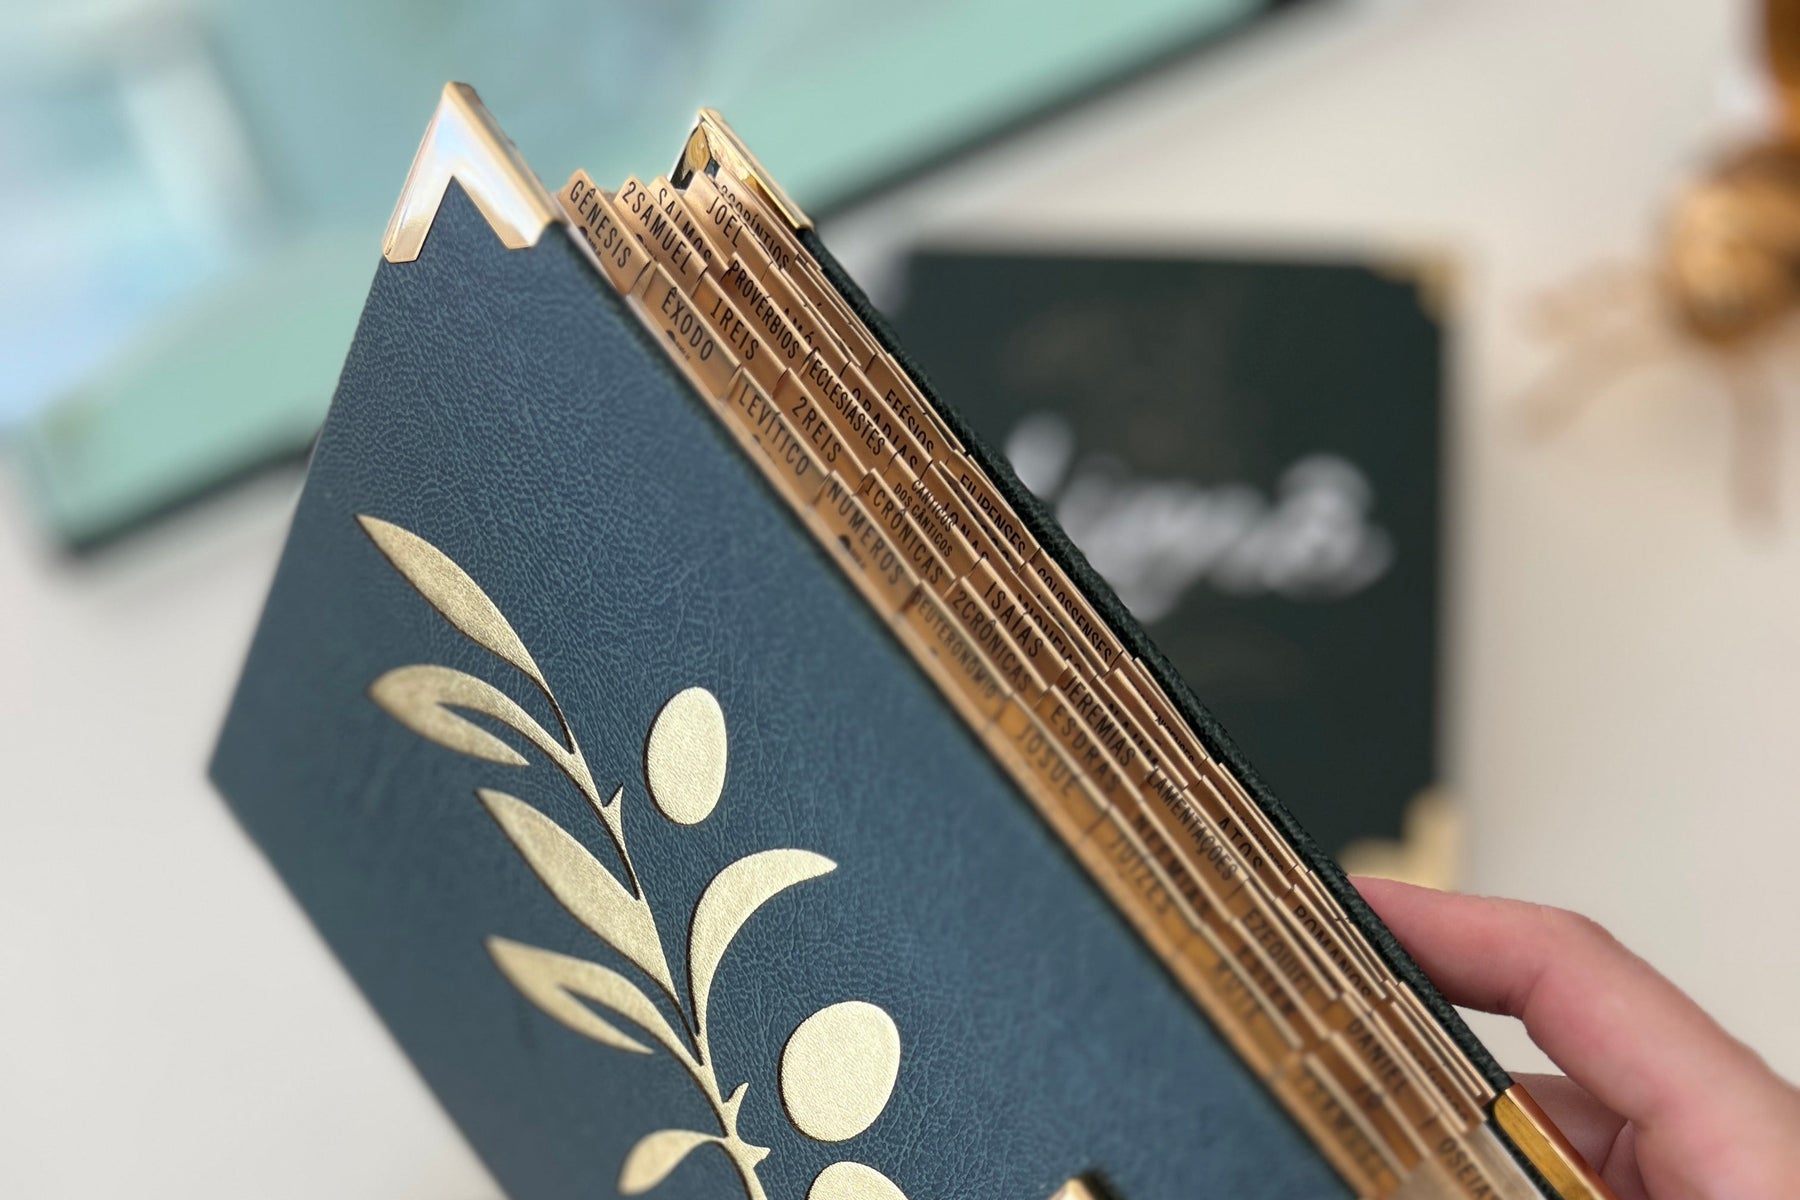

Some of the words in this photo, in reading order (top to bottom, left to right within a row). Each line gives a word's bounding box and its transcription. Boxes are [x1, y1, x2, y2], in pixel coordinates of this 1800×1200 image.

[570, 179, 632, 269] GÊNESIS
[621, 182, 691, 275] 2SAMUEL
[658, 188, 712, 263] SALMOS
[706, 197, 746, 248] JOEL
[661, 287, 714, 362] ÊXODO
[709, 298, 760, 361] 1REIS
[727, 260, 800, 359] PROVÉRBIOS
[738, 383, 810, 477] LEVÍTICO
[791, 396, 842, 463] 2REIS
[808, 357, 885, 456] ECLESIASTES
[864, 478, 943, 585] 1CRÔNICAS
[893, 482, 912, 508] DOS
[912, 501, 953, 557] CÂNTICOS
[952, 591, 1032, 693] 2CRÔNICAS
[984, 581, 1044, 658] ISAÍAS
[1050, 706, 1120, 793] ESDRAS
[1061, 676, 1135, 768] JEREMIAS
[1218, 816, 1264, 868] ATOS
